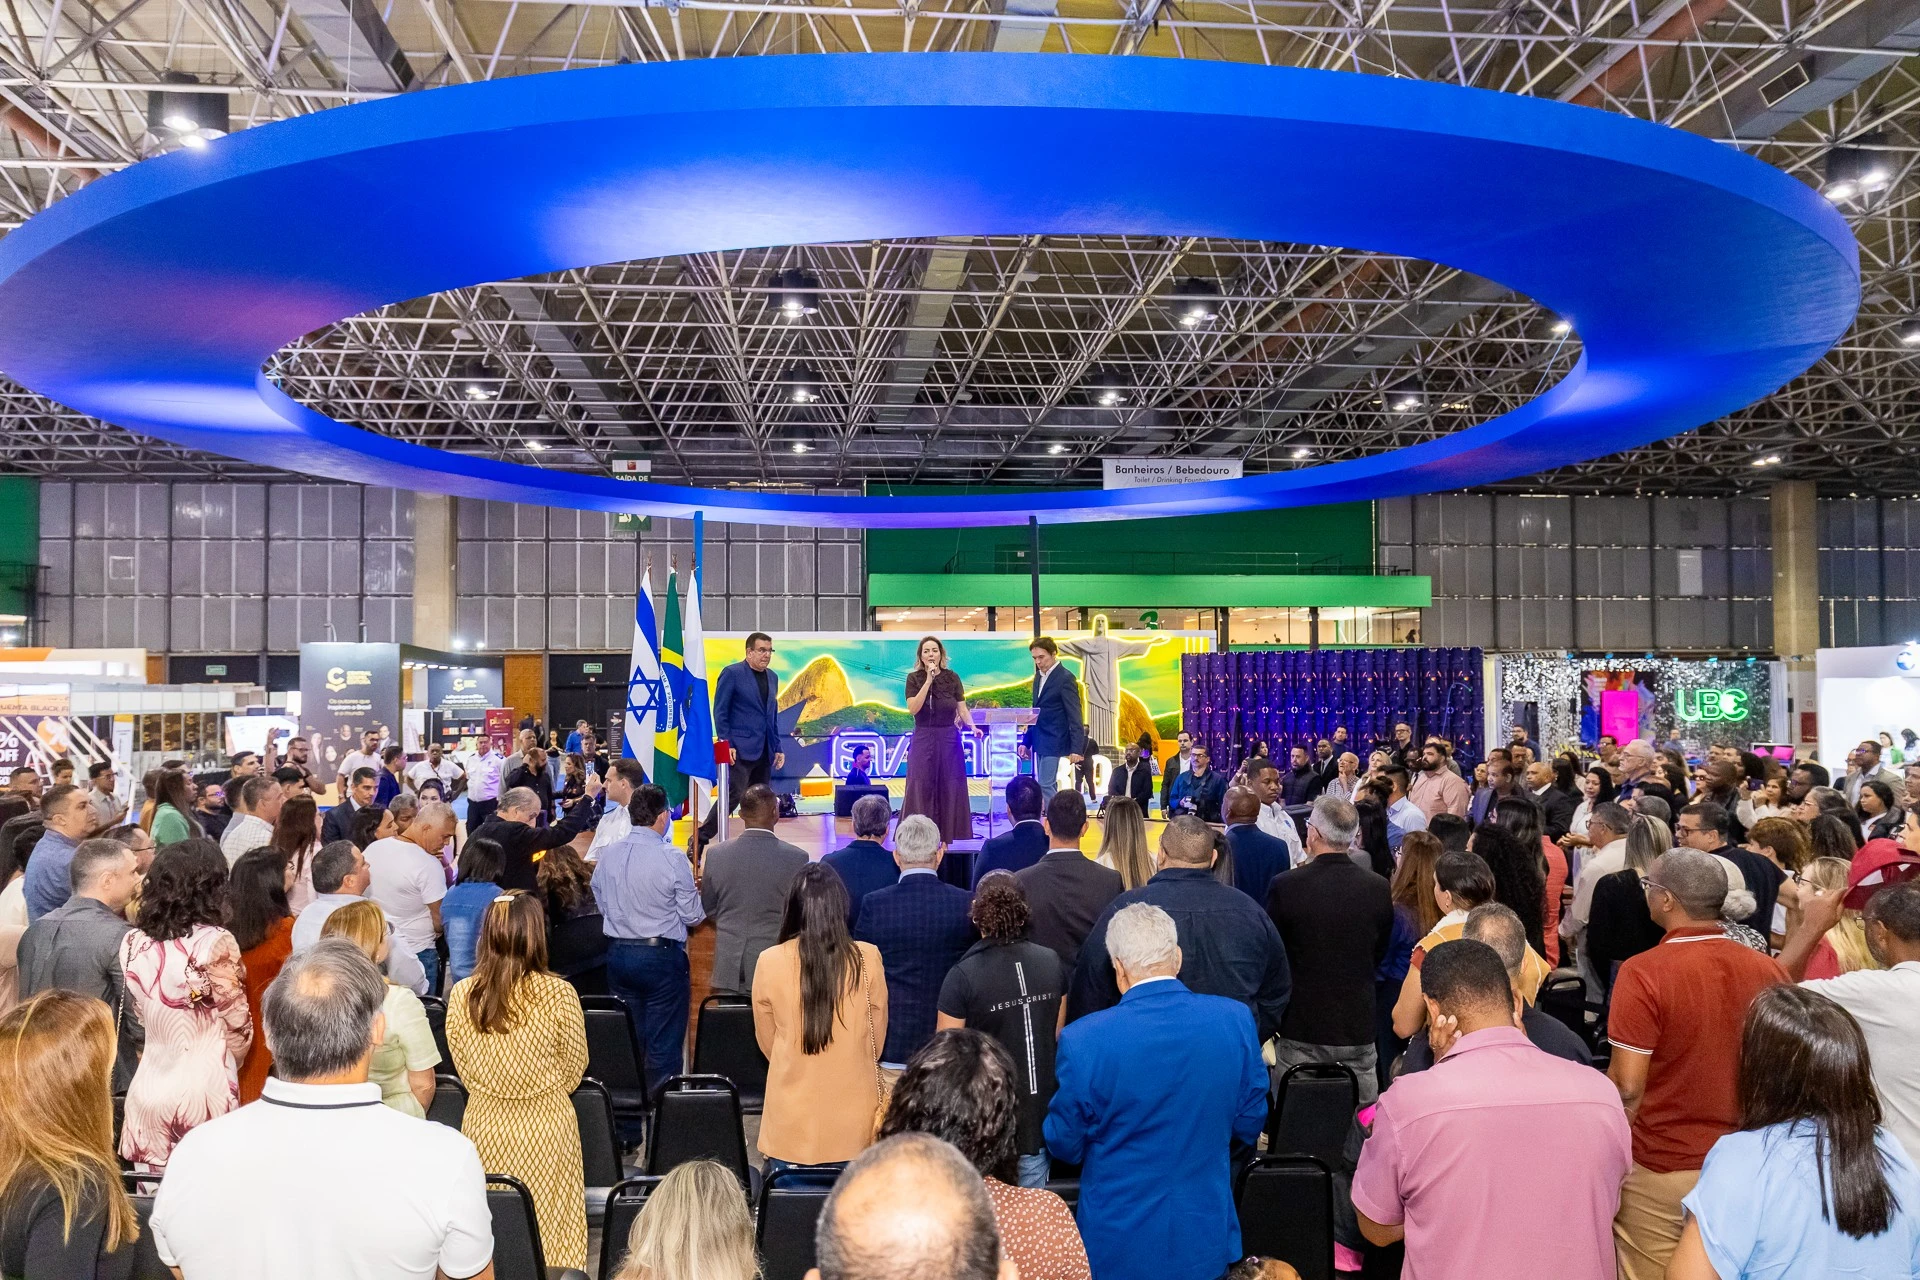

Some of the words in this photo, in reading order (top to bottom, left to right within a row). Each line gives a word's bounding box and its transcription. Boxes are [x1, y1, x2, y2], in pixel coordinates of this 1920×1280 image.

[1115, 465, 1165, 474] Banheiros
[1168, 465, 1173, 475] /
[1176, 465, 1230, 475] Bebedouro
[1157, 476, 1183, 485] Drinking
[1677, 688, 1749, 722] UBC
[990, 998, 1024, 1012] JESUS
